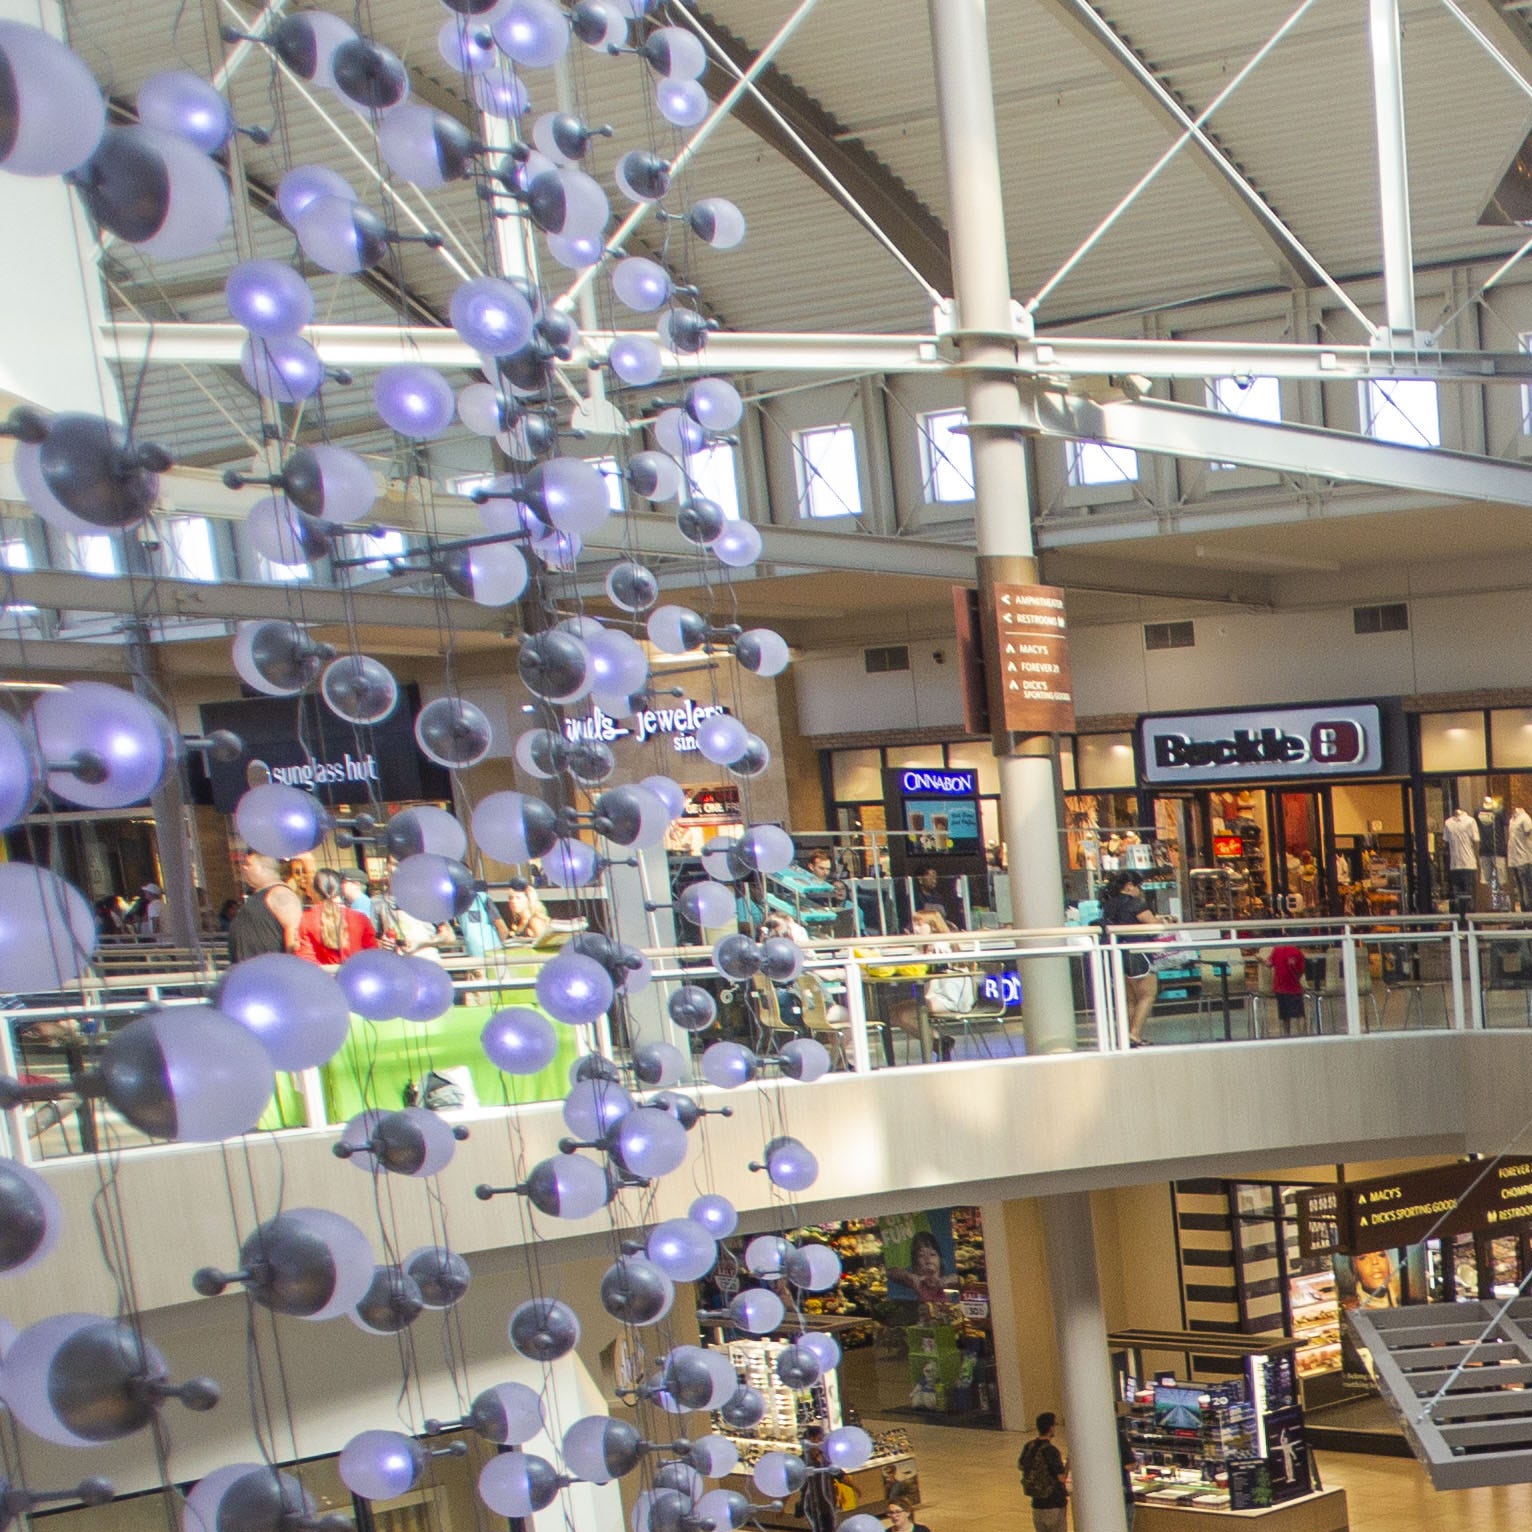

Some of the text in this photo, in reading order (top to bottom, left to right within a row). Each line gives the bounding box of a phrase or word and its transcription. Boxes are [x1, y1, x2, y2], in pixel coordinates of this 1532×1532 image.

[1019, 643, 1049, 656] MACY'S
[1020, 661, 1053, 673] FOREVER
[1153, 727, 1311, 768] Buckle
[272, 753, 379, 791] sunglass hut
[1498, 1164, 1529, 1178] FOREVER
[1369, 1187, 1402, 1202] MACY'S
[1371, 1209, 1397, 1225] DICK'S
[1397, 1204, 1432, 1220] SPORTING
